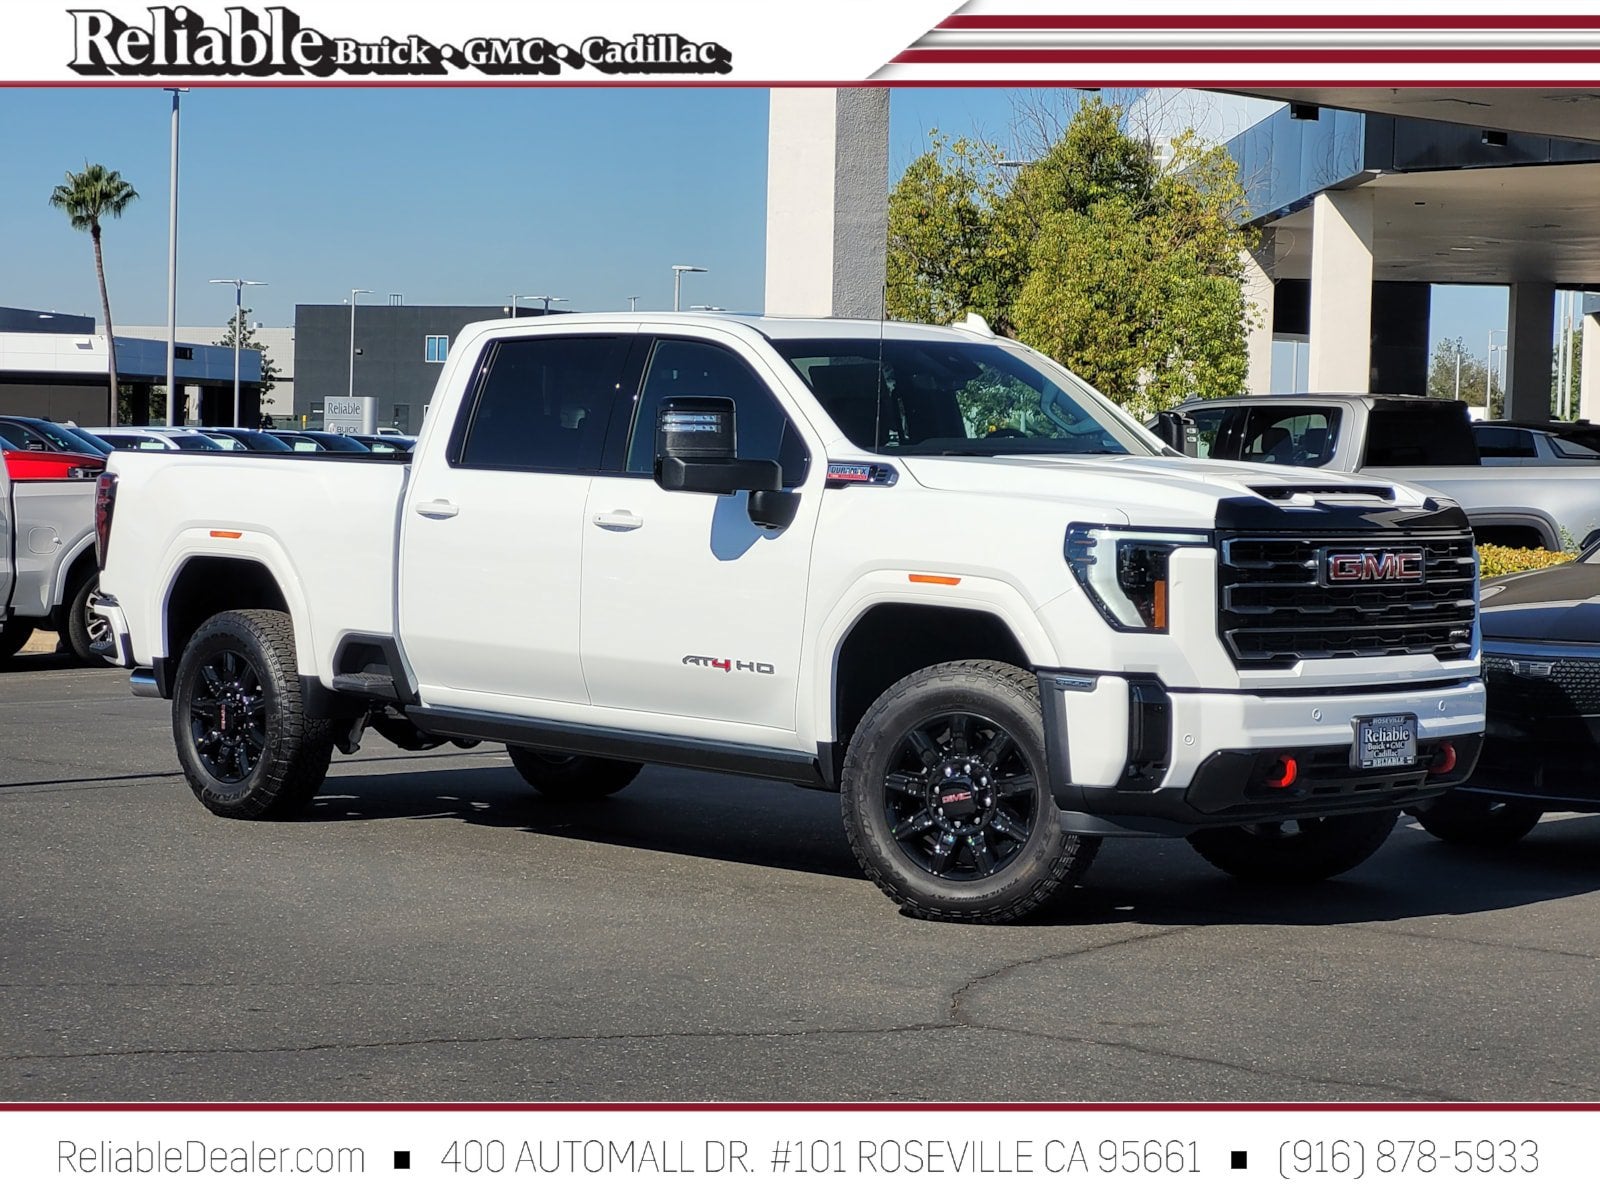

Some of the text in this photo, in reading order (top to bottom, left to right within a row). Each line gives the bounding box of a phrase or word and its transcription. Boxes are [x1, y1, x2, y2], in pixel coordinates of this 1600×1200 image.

[328, 402, 361, 415] Reliable
[336, 425, 359, 434] BUICK
[1329, 552, 1423, 580] GMC
[682, 655, 775, 675] AT4 HD
[1364, 726, 1410, 743] Reliable
[1368, 743, 1386, 751] Buick
[1373, 749, 1399, 758] Cadillac
